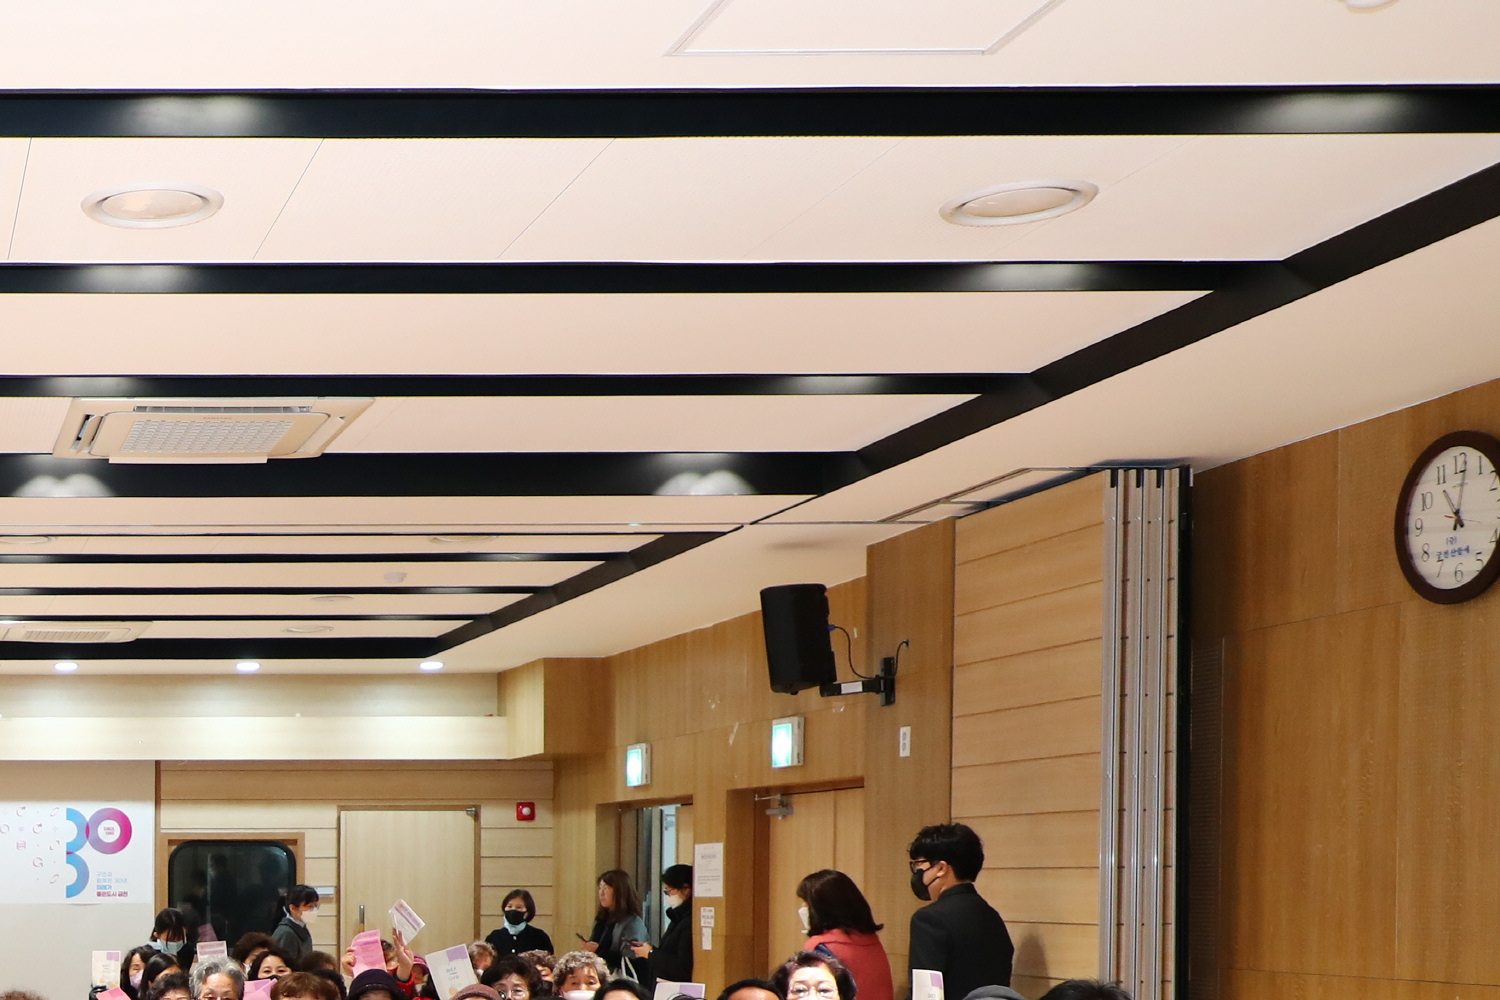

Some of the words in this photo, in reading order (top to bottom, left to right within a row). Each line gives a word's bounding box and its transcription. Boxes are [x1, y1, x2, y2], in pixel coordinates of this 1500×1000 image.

[1453, 452, 1467, 475] 12
[1478, 455, 1483, 476] 1
[1436, 464, 1447, 485] 11
[1421, 491, 1434, 511] 10
[1414, 518, 1424, 537] 9
[1421, 543, 1430, 562] 8
[1436, 559, 1444, 578] 7
[1454, 563, 1463, 583] 6
